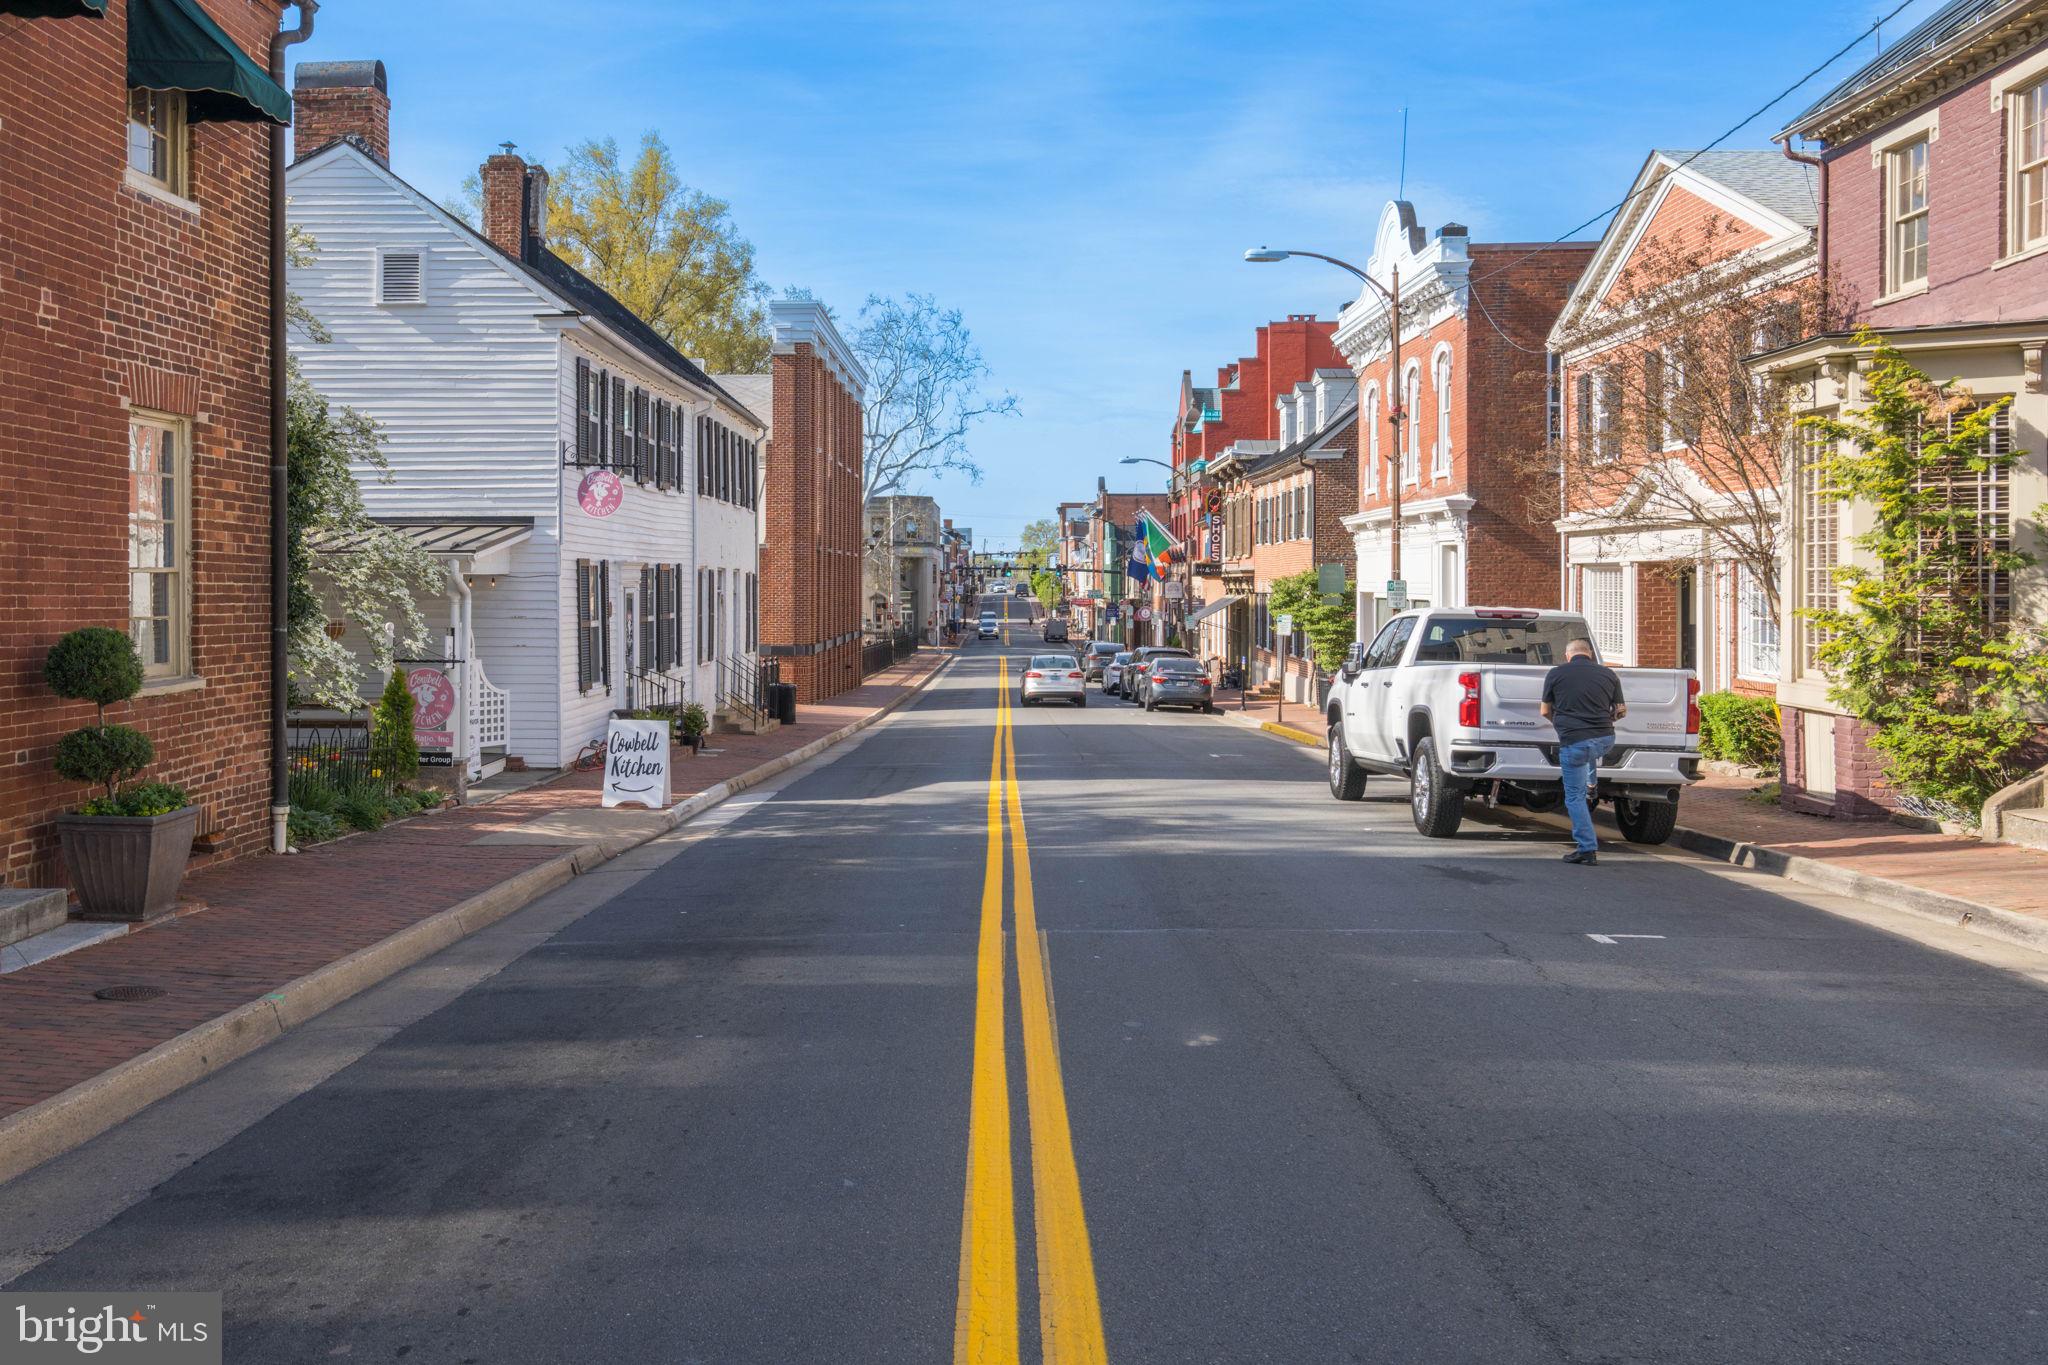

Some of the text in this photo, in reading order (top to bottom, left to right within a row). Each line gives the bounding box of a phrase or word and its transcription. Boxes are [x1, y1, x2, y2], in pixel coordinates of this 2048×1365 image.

[586, 503, 616, 515] KITCHEN
[1211, 515, 1221, 561] SHOES
[410, 672, 442, 687] Cowbell
[412, 710, 443, 726] ITCHEN
[609, 731, 659, 755] Cowbell
[430, 756, 451, 764] Group
[611, 755, 663, 778] Kitchen
